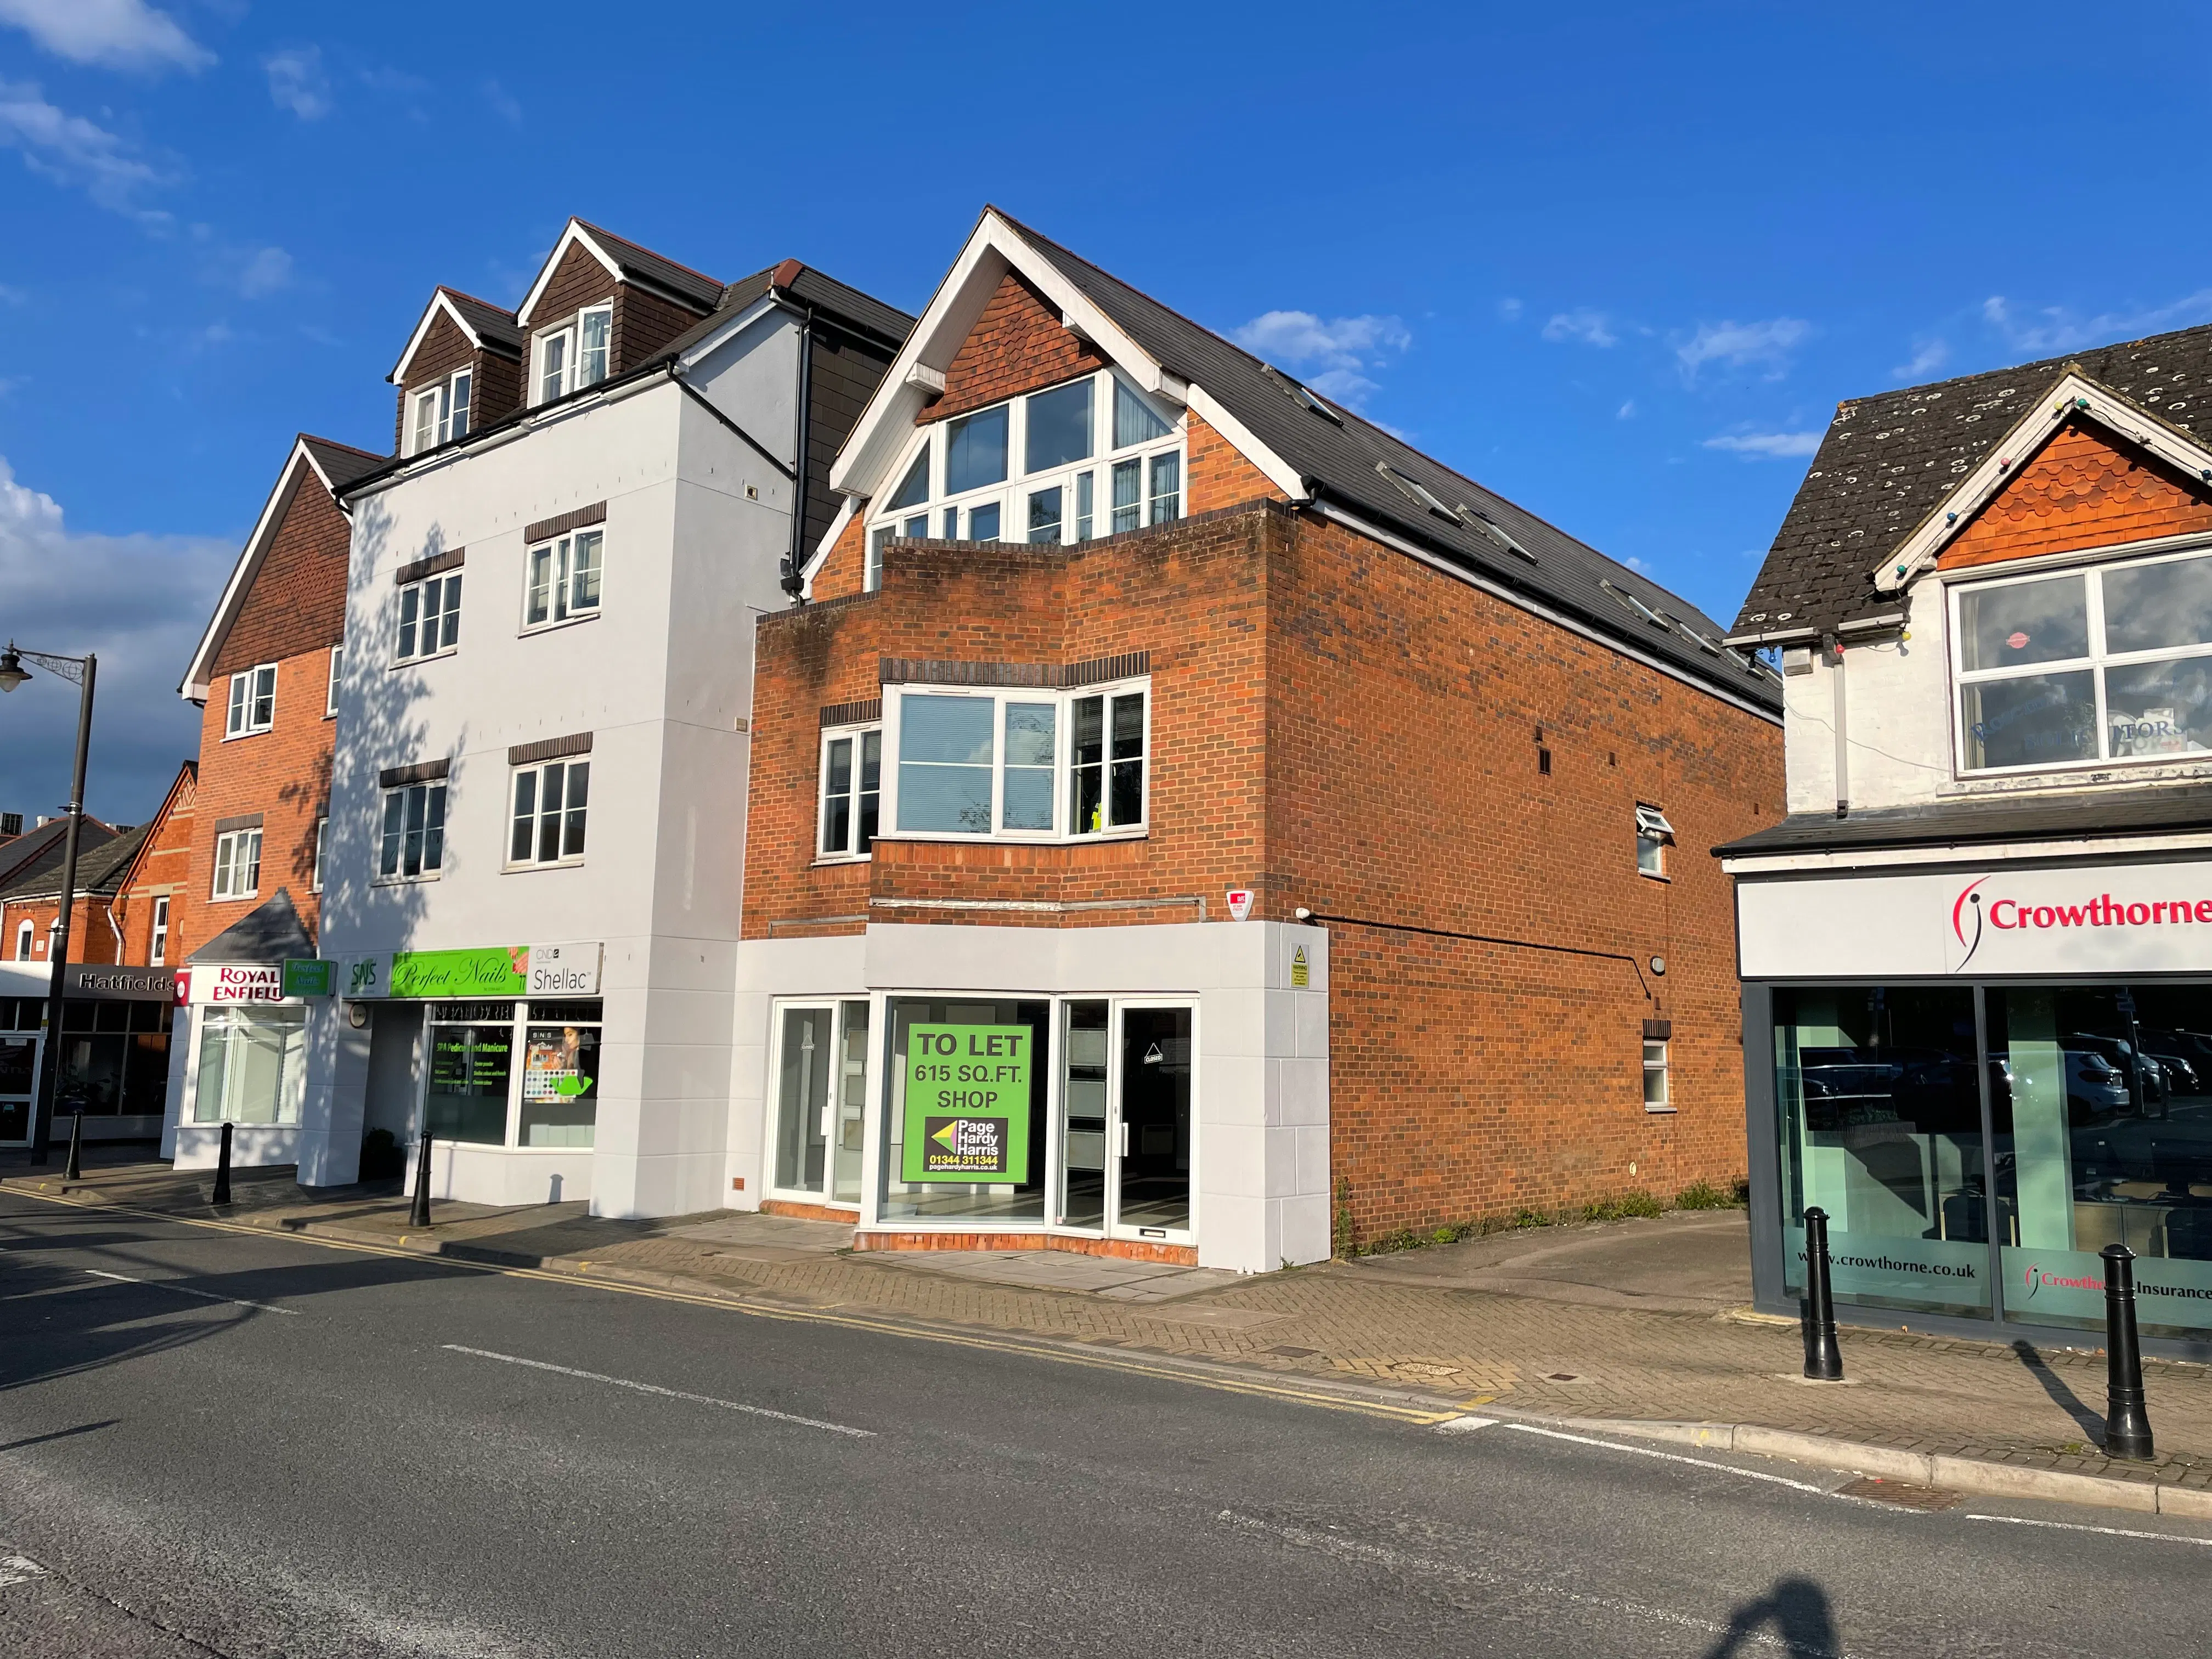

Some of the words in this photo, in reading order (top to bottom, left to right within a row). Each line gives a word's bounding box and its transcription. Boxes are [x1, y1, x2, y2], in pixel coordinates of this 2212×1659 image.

[1990, 893, 2212, 929] Crowthorne
[536, 949, 552, 960] CND
[80, 973, 174, 992] Hatfields
[220, 968, 279, 984] ROYAL
[352, 962, 377, 986] SNS
[393, 961, 451, 994] Perfect
[454, 957, 507, 985] Nails
[534, 968, 586, 990] Shellac
[482, 1042, 508, 1052] Manicure
[917, 1034, 957, 1056] TO
[969, 1034, 1023, 1057] LET
[915, 1064, 950, 1082] 615
[958, 1065, 1022, 1082] SQ.FT.
[937, 1090, 997, 1108] SHOP
[958, 1120, 995, 1135] Page
[957, 1132, 998, 1147] Hardy
[957, 1143, 998, 1155] Harris
[929, 1155, 960, 1164] 01344
[962, 1155, 998, 1165] 311344
[1797, 1251, 1976, 1278] w.crowthorne.co.uk
[2042, 1272, 2106, 1290] Crowtho
[2137, 1280, 2212, 1300] Insurance
